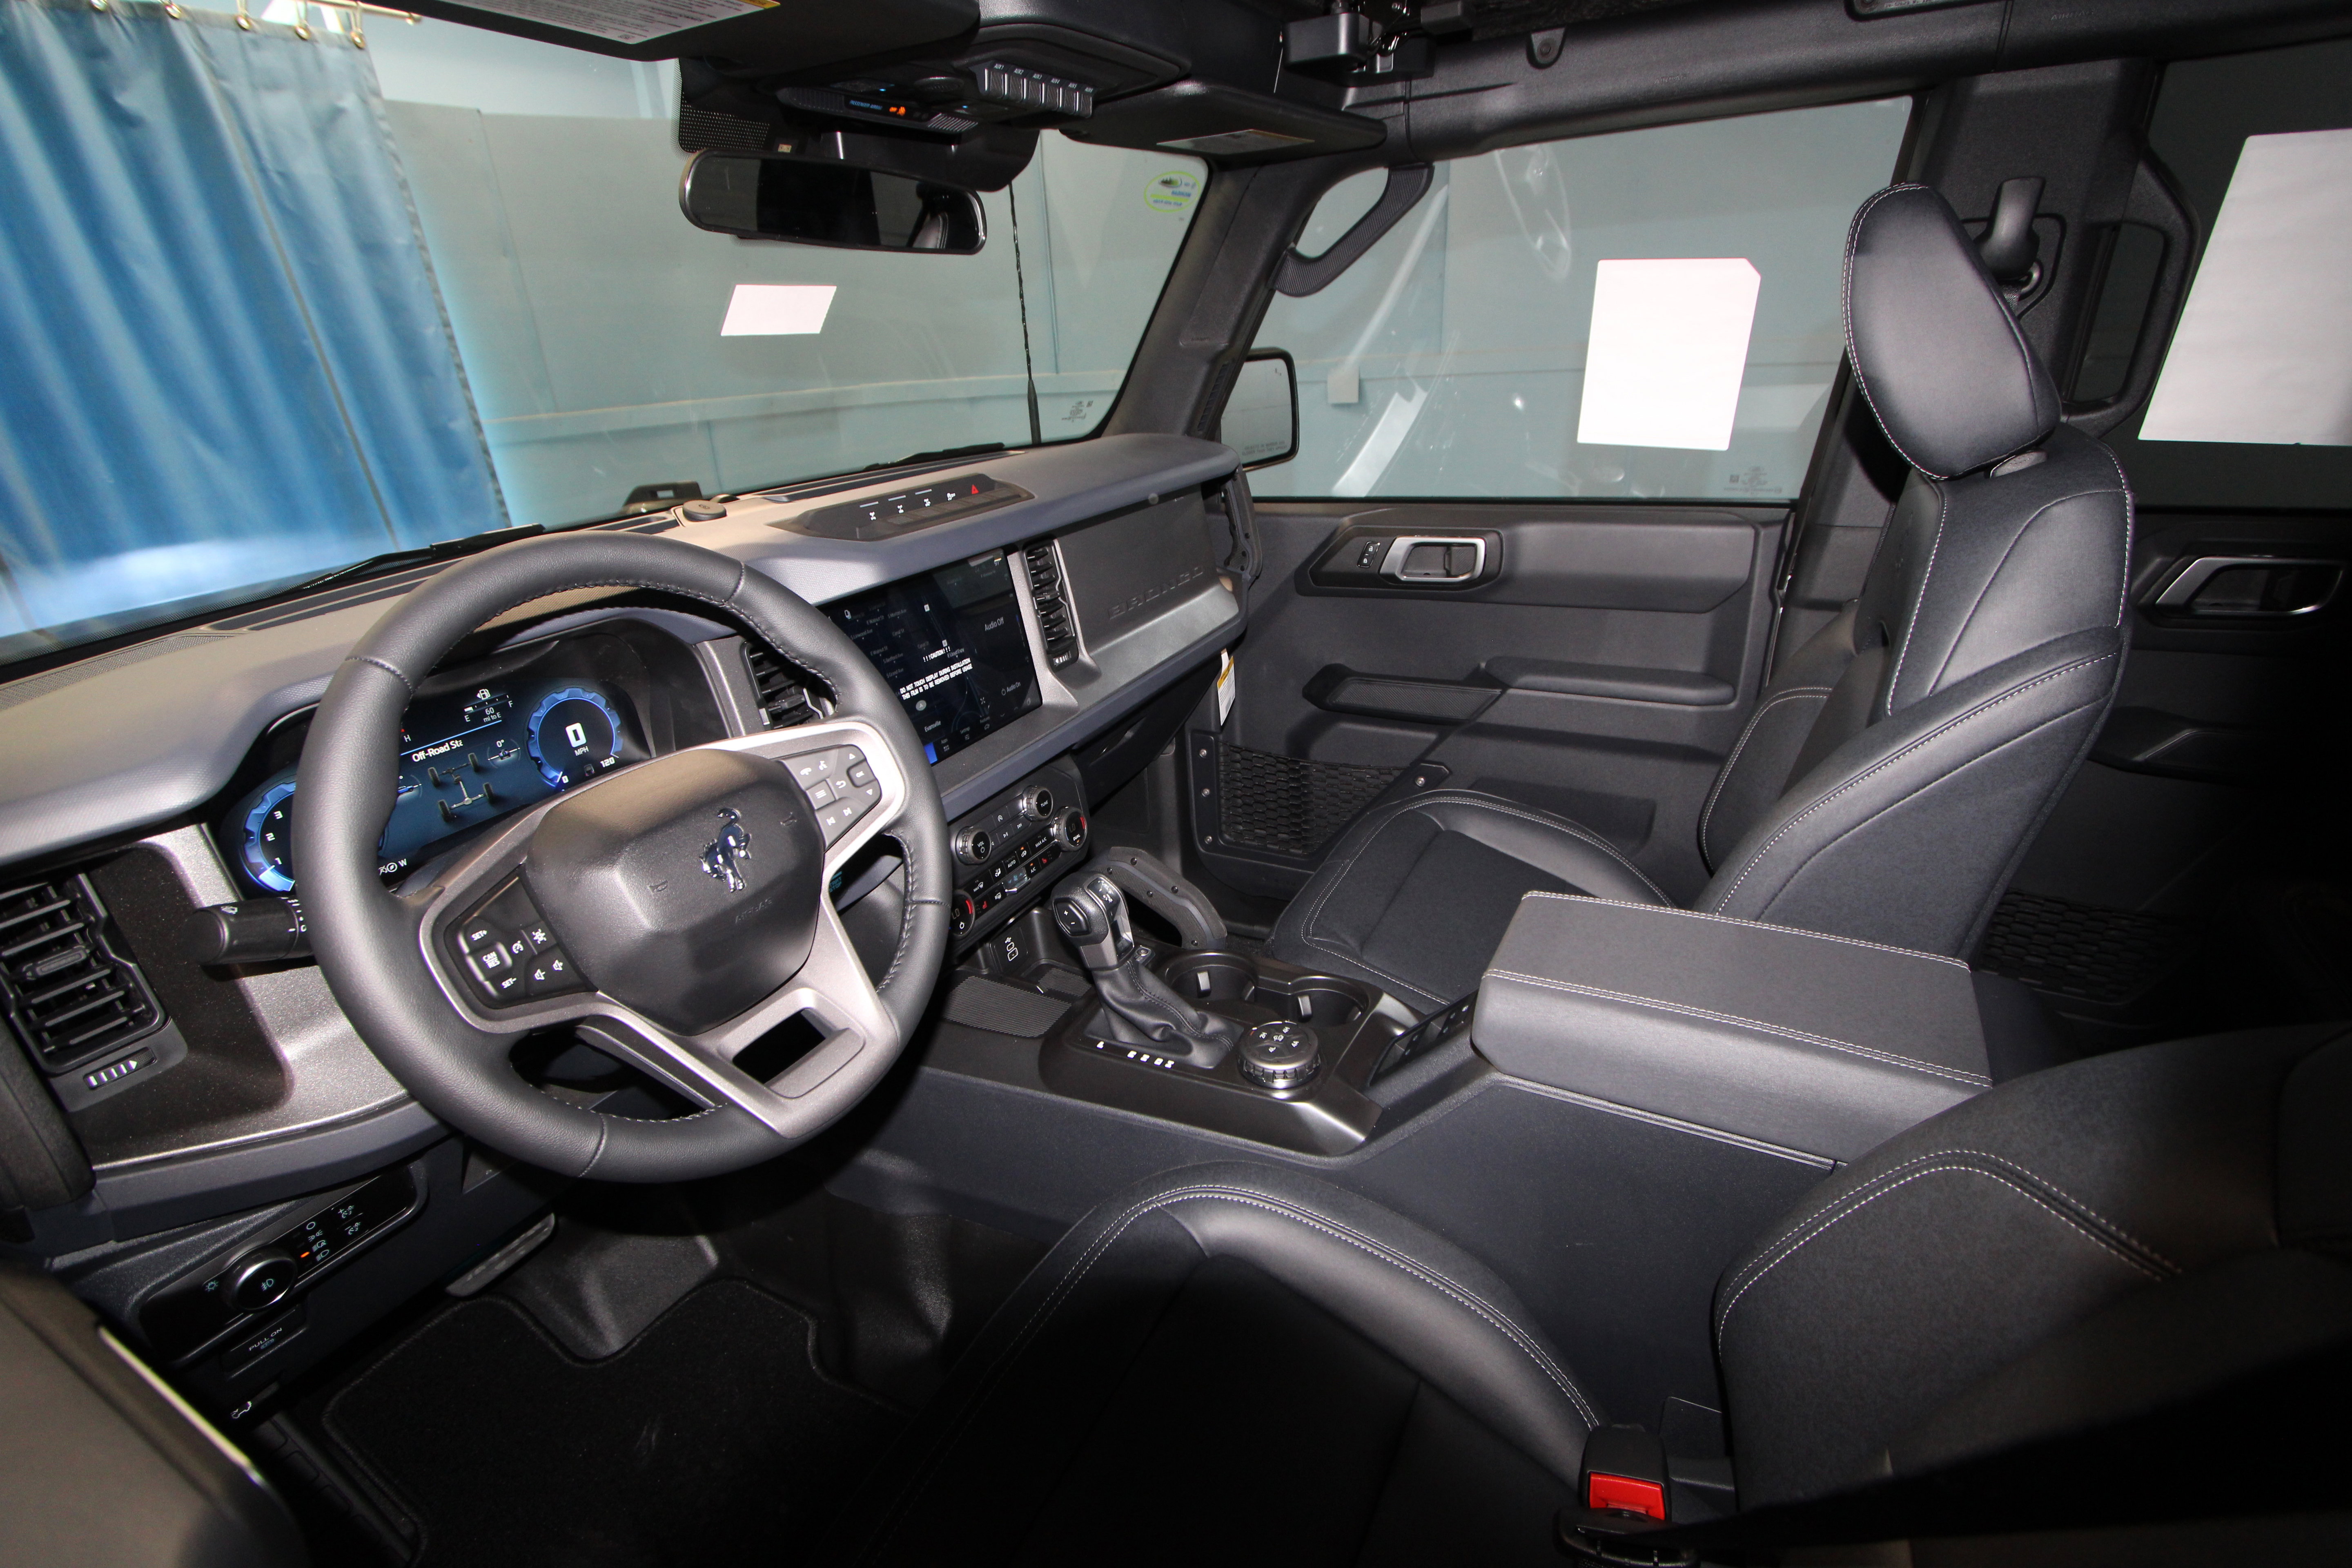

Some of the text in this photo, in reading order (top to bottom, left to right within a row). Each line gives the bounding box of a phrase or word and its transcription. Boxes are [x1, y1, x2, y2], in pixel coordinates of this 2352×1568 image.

[984, 621, 997, 631] Audio
[914, 679, 925, 687] TOUCH
[925, 672, 938, 682] DISPLAY
[939, 667, 951, 676] DURING
[951, 658, 971, 670] INSTALLATION
[934, 675, 949, 685] REMOVED
[949, 668, 962, 678] BEFORE
[962, 664, 973, 673] USAGE
[1007, 684, 1016, 693] Audio
[485, 707, 494, 715] 60
[924, 720, 941, 732] Evansville
[566, 722, 587, 748] 0
[412, 742, 450, 762] Off-Road
[575, 746, 589, 756] MPH
[600, 757, 615, 768] 120
[561, 775, 569, 784] 0
[274, 811, 283, 820] 3
[265, 833, 275, 841] 2
[398, 858, 407, 867] W
[471, 930, 487, 941] SET+
[483, 951, 497, 962] CAN
[486, 960, 501, 969] RES
[249, 1327, 282, 1351] PULL ON
